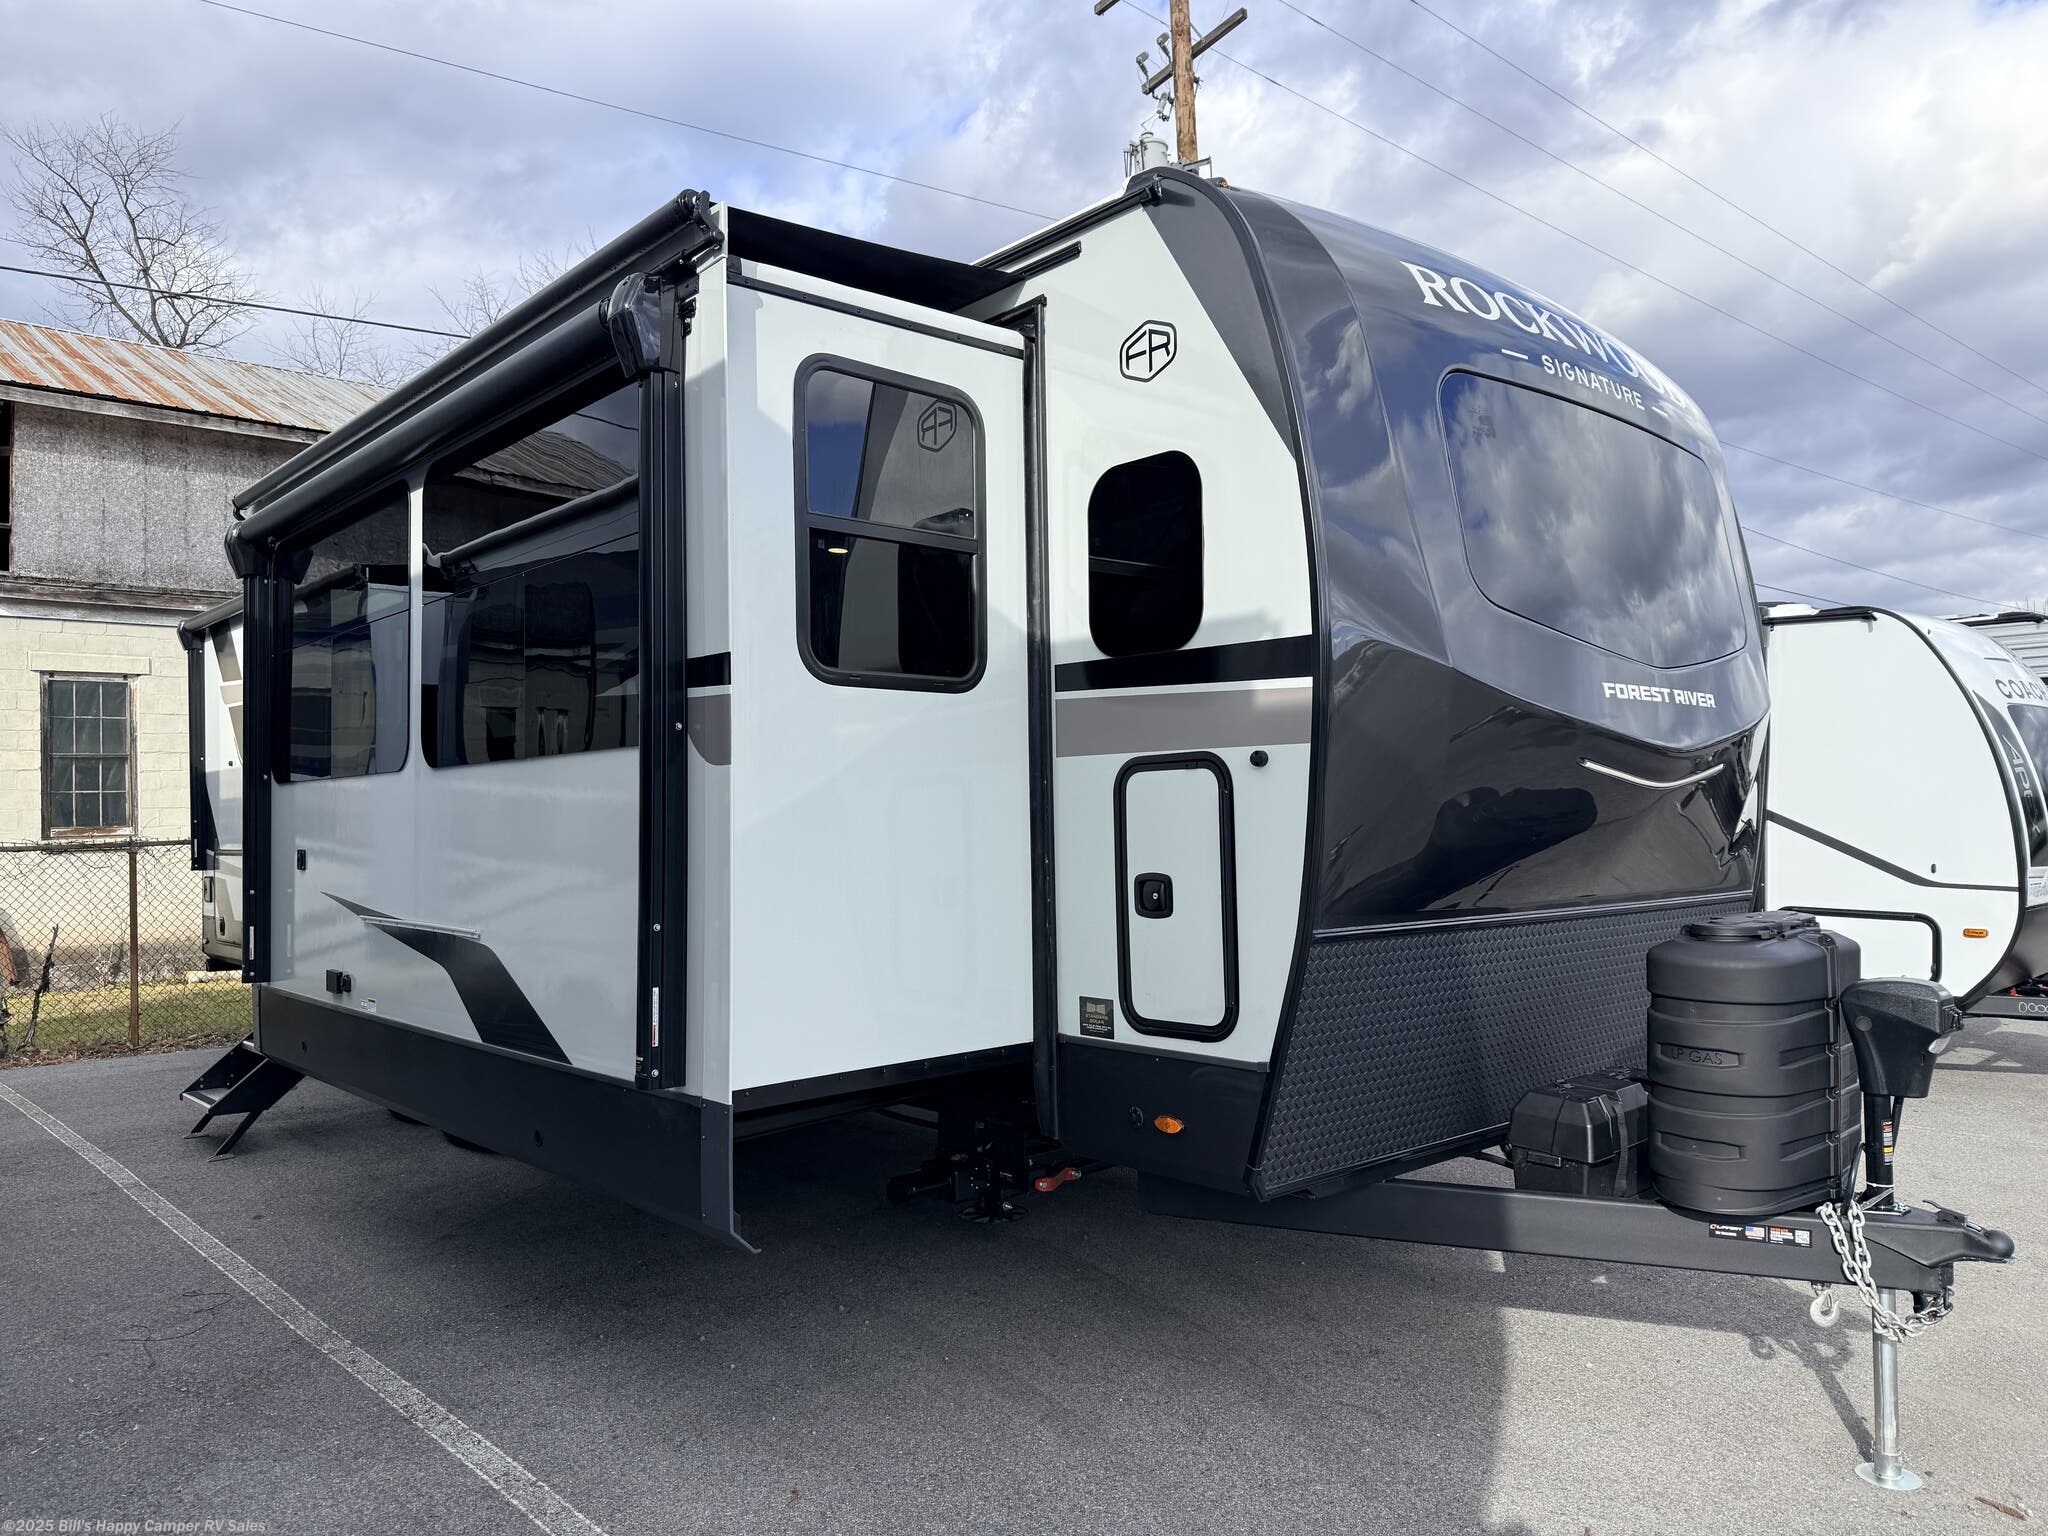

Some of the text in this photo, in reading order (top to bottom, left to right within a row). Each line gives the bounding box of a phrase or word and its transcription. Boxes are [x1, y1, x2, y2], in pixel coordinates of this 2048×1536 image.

[1541, 354, 1645, 410] SIGNATURE
[1601, 681, 1716, 708] FOREST RIVER
[1671, 1047, 1723, 1065] LP GAS
